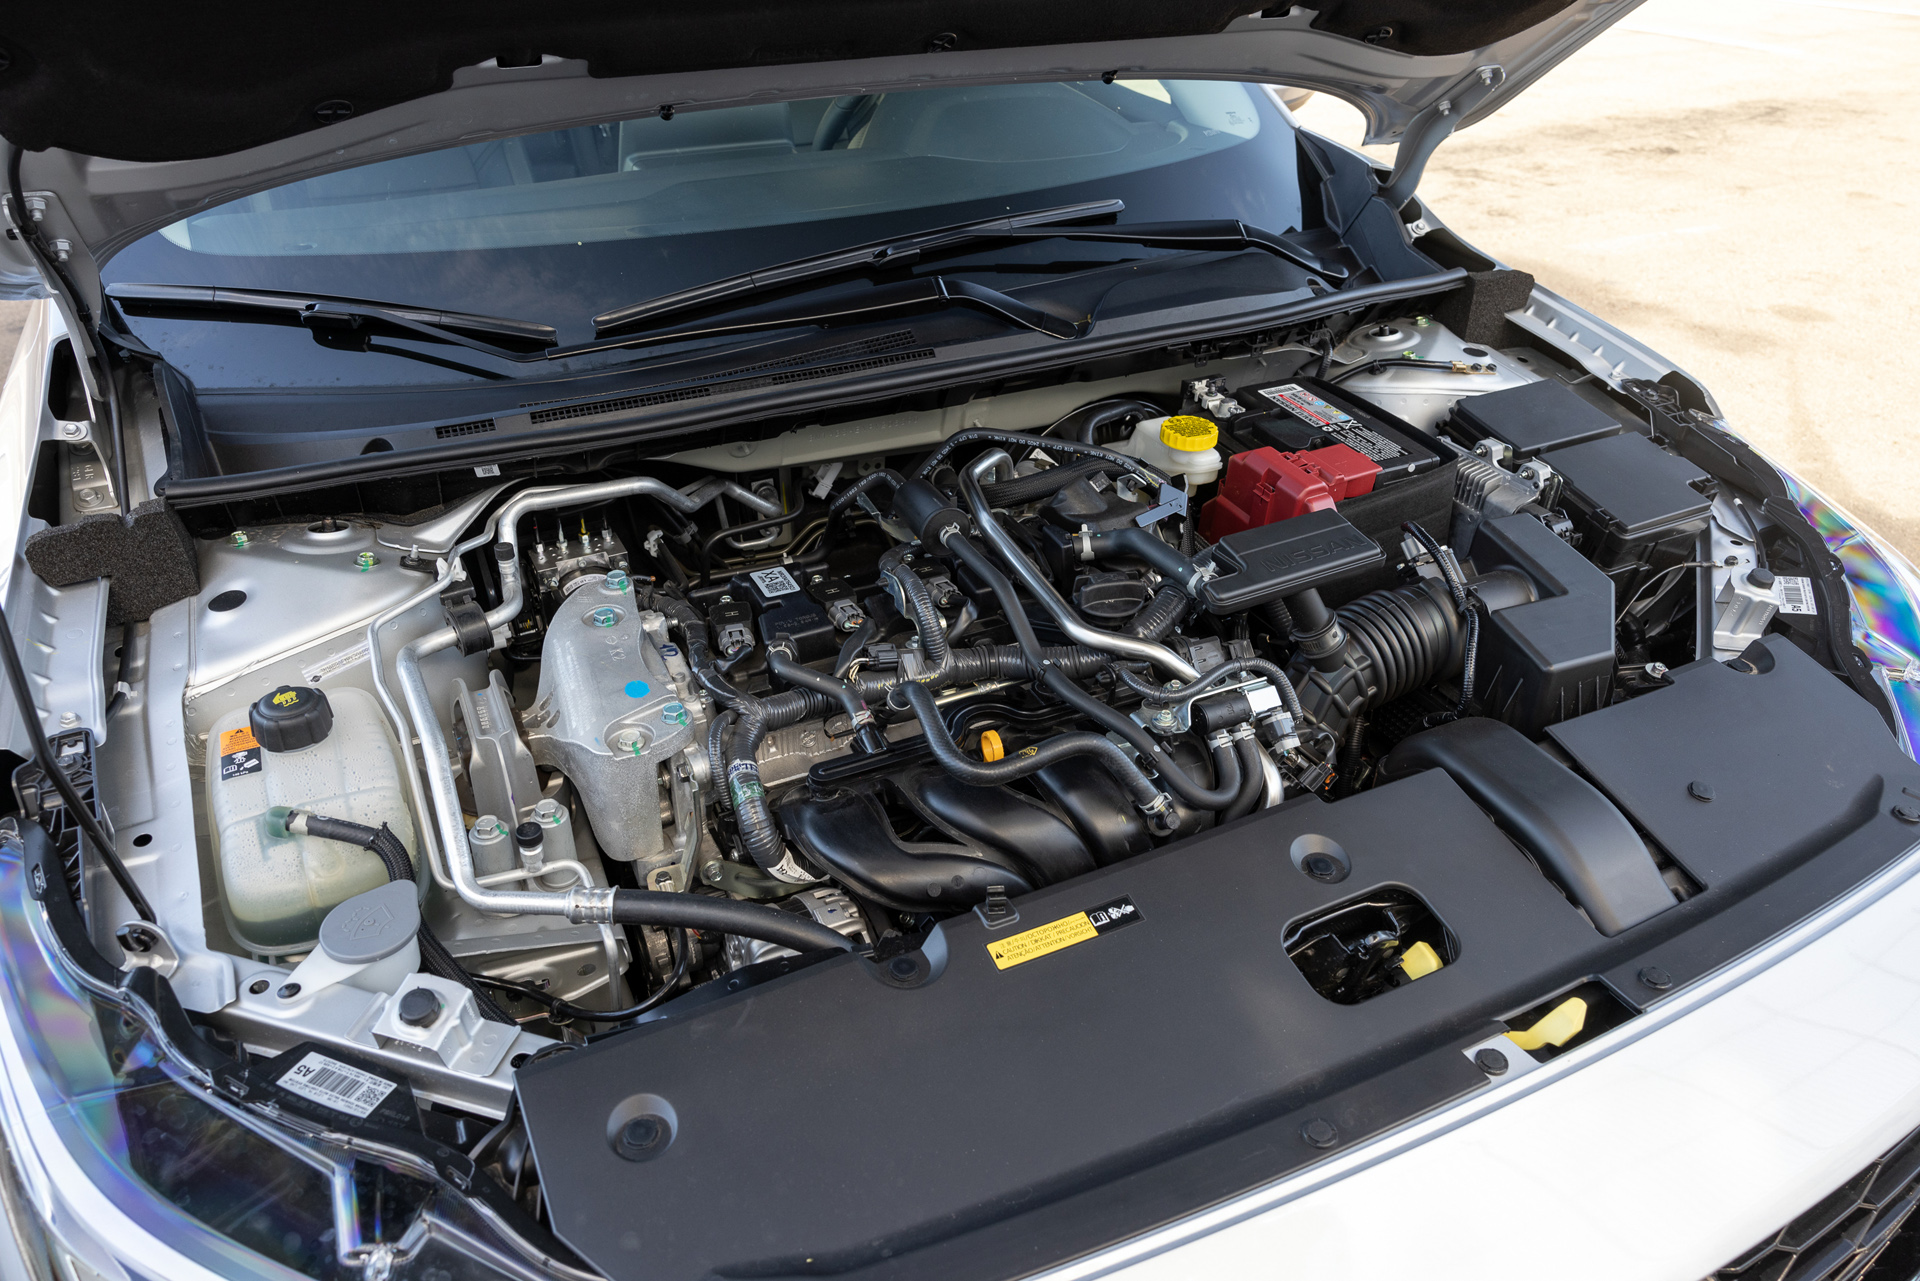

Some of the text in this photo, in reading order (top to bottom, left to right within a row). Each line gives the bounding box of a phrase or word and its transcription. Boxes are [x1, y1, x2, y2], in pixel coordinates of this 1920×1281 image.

[1260, 533, 1367, 572] NISSAN
[761, 570, 779, 583] XA
[294, 1064, 316, 1077] A5
